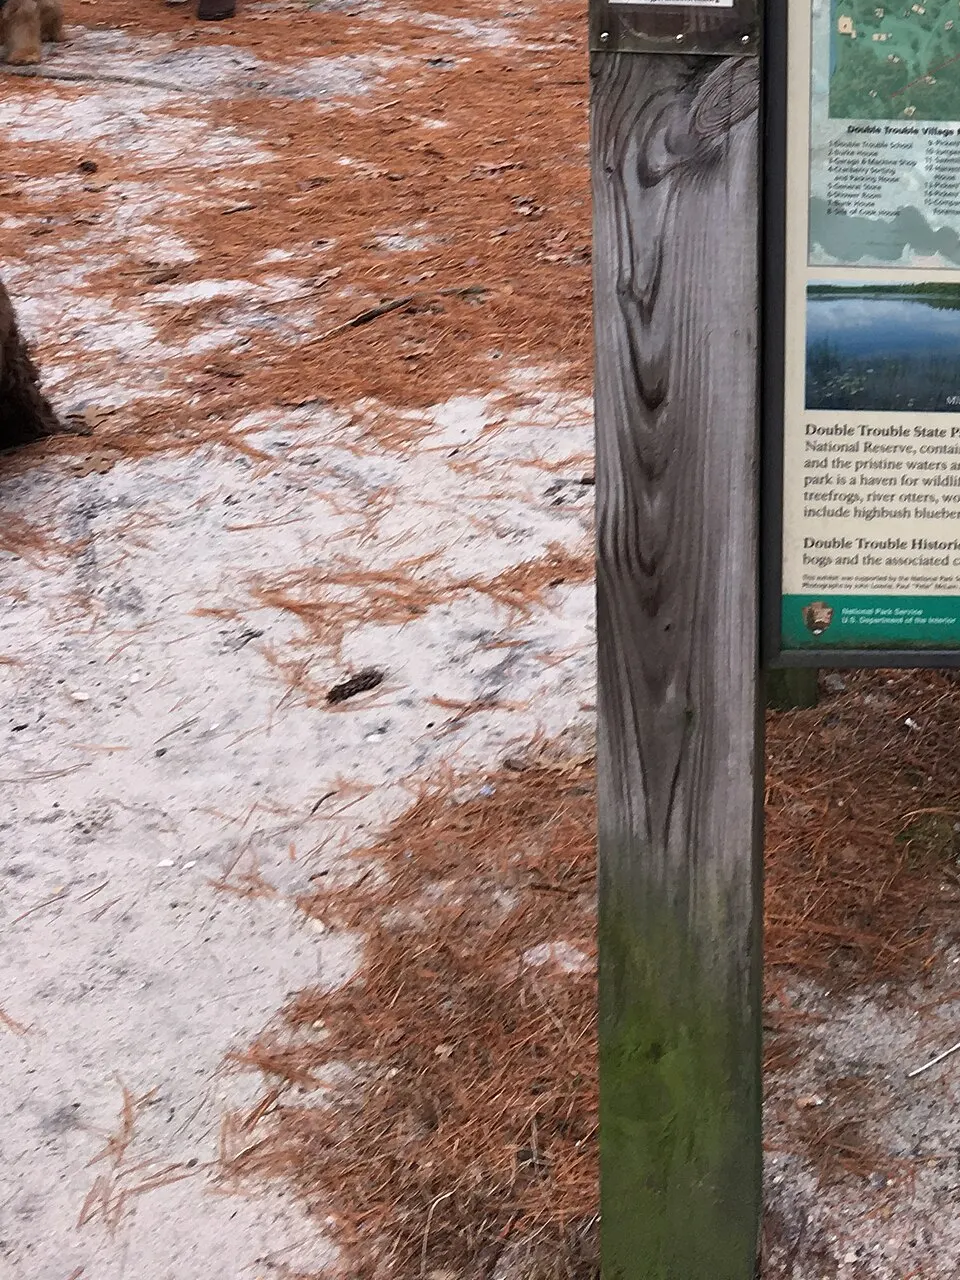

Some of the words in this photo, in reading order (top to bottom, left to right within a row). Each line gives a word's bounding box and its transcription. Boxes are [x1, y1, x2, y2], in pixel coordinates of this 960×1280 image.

[847, 125, 882, 134] Double
[884, 126, 919, 135] Trouble
[921, 127, 955, 137] Village
[804, 423, 856, 436] Double
[856, 425, 912, 437] Trouble
[913, 425, 948, 438] State
[804, 440, 860, 453] National
[862, 441, 918, 456] Reserve,
[803, 457, 829, 468] and
[831, 457, 853, 469] the
[854, 458, 904, 472] pristine
[905, 461, 948, 471] waters
